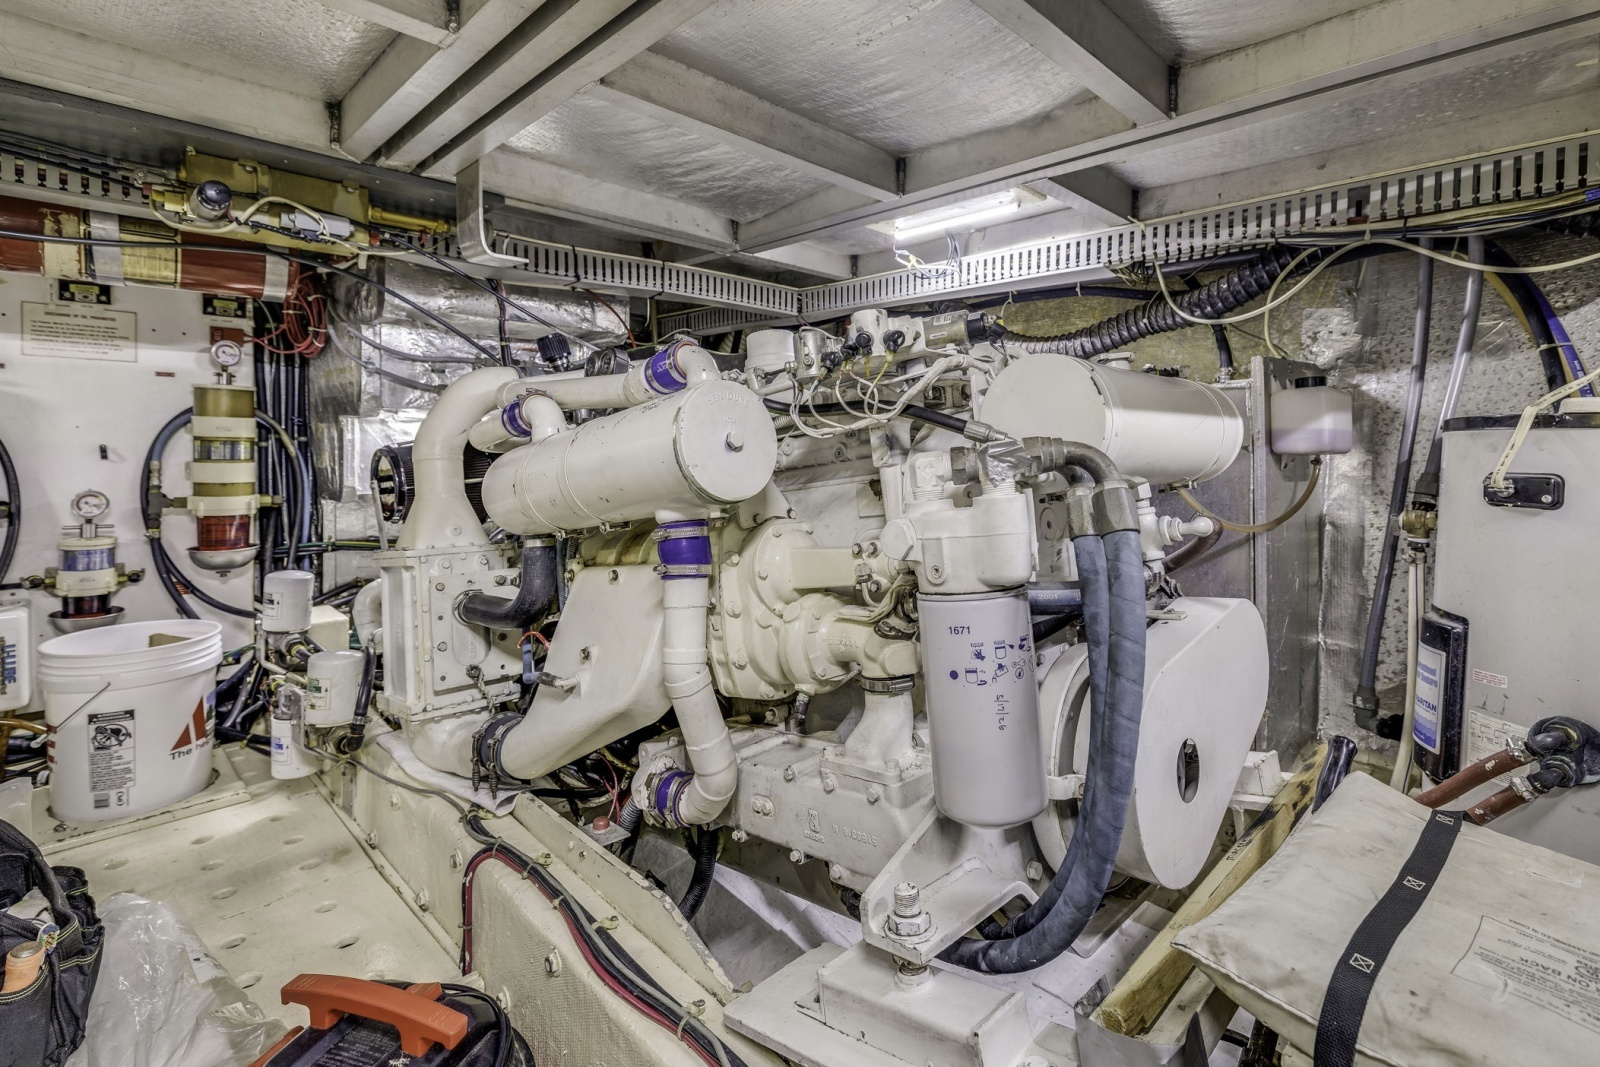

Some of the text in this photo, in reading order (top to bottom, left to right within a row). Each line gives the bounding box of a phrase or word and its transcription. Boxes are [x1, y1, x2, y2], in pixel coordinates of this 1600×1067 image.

[948, 626, 971, 635] 1671
[169, 748, 193, 760] The
[1518, 955, 1562, 977] BACK
[1566, 974, 1591, 989] ON
